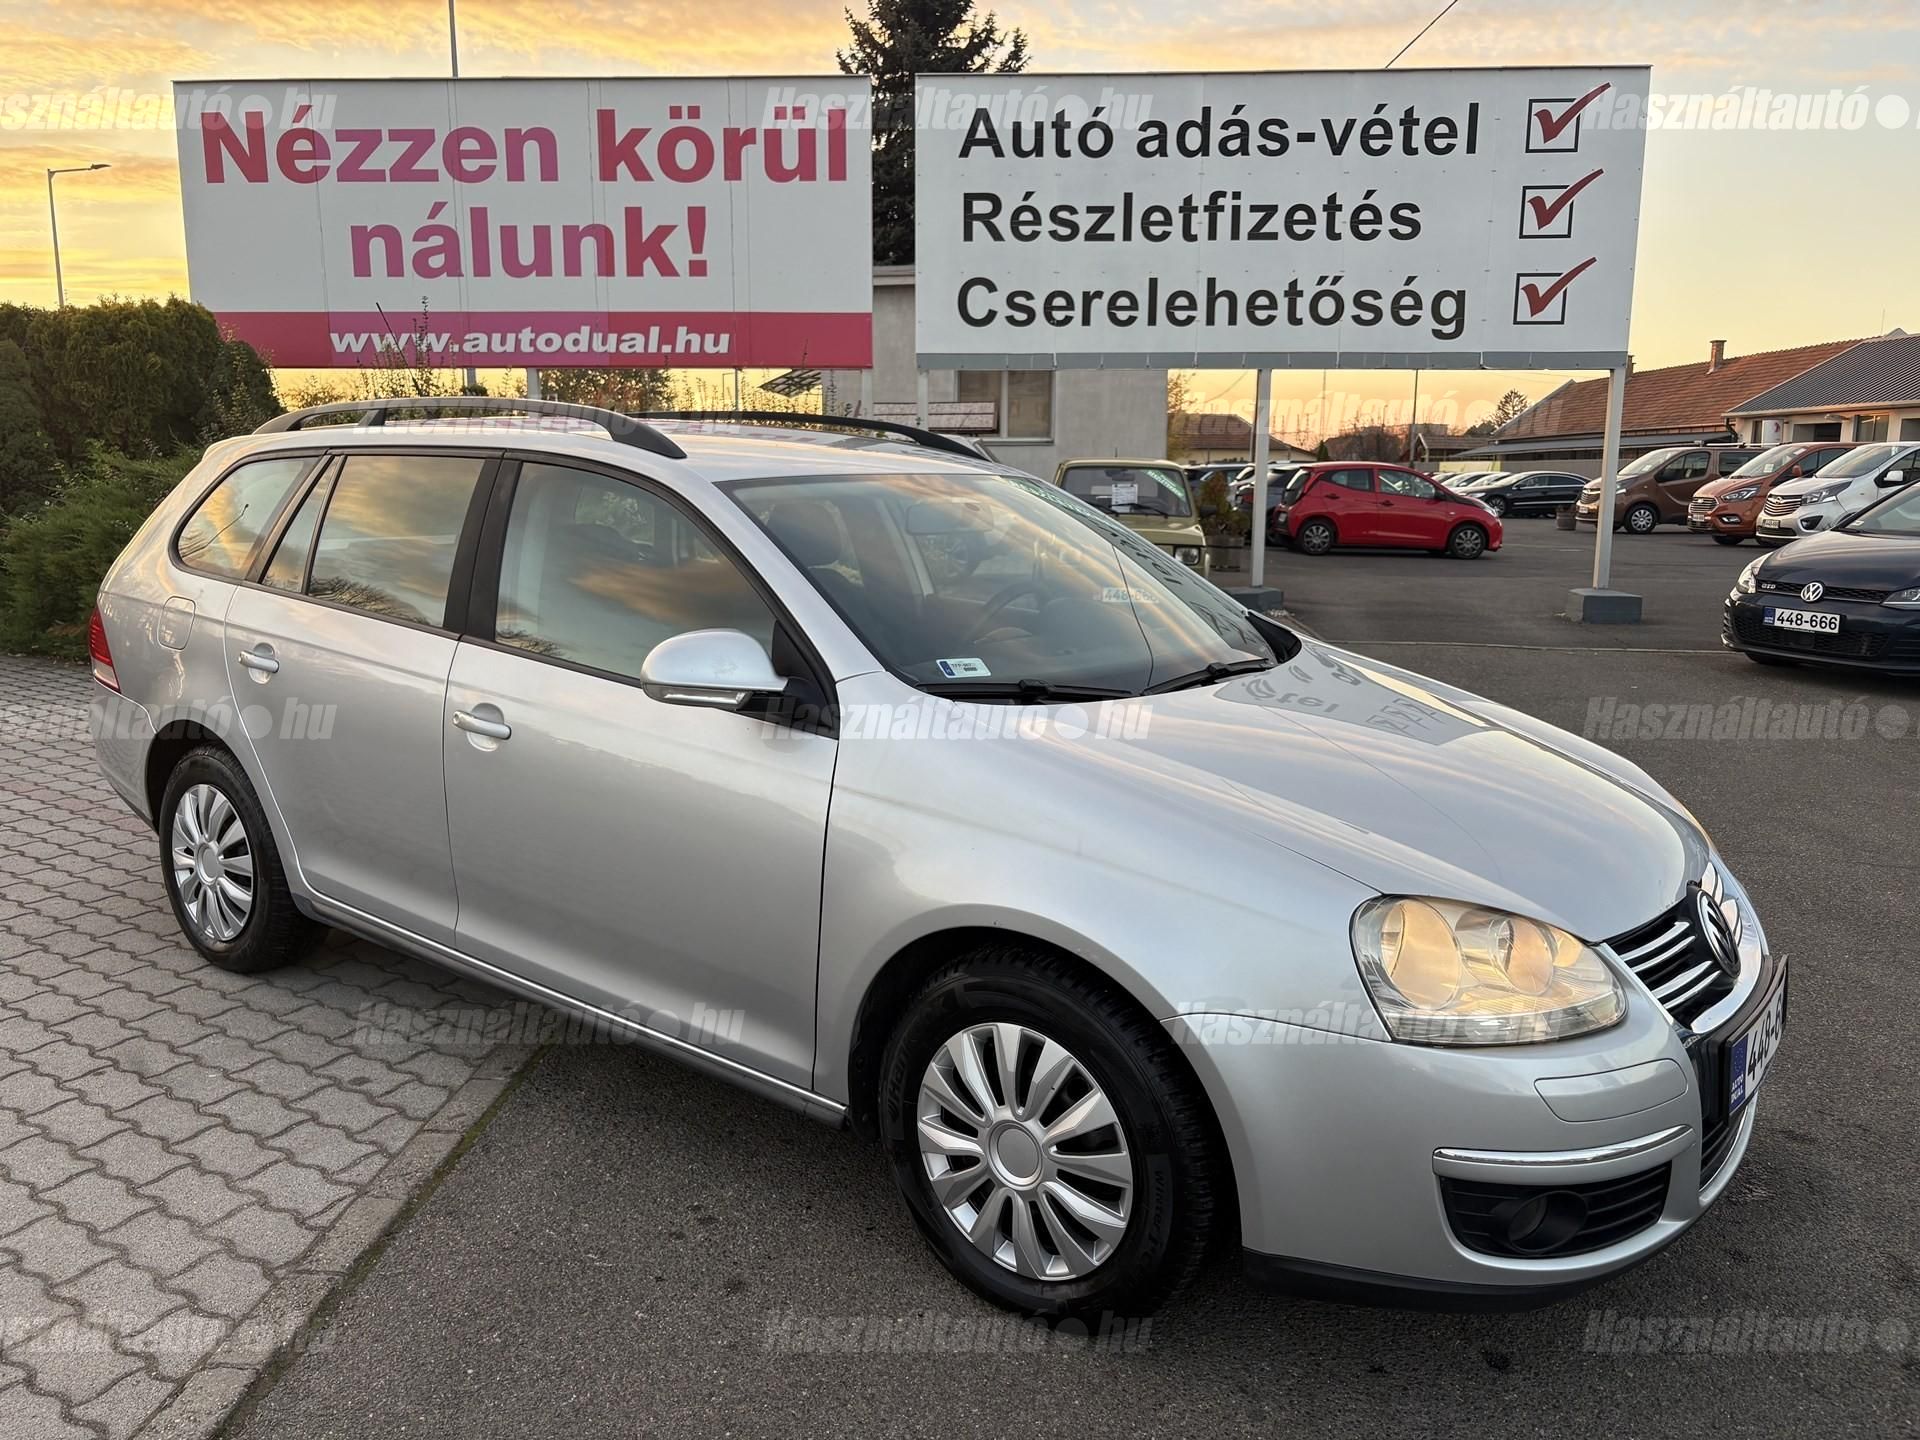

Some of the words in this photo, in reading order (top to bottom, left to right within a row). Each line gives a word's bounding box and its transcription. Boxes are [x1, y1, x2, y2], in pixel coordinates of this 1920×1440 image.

[201, 105, 558, 185] Nézzen
[597, 106, 848, 184] körül
[959, 107, 1113, 159] Autó
[1137, 103, 1479, 159] adás-vétel
[351, 202, 709, 279] nálunk!
[964, 190, 1421, 243] Részletfizetés
[958, 275, 1466, 340] Cserelehetőség
[330, 326, 730, 355] www.autodual.hu
[1776, 611, 1838, 631] 448-666
